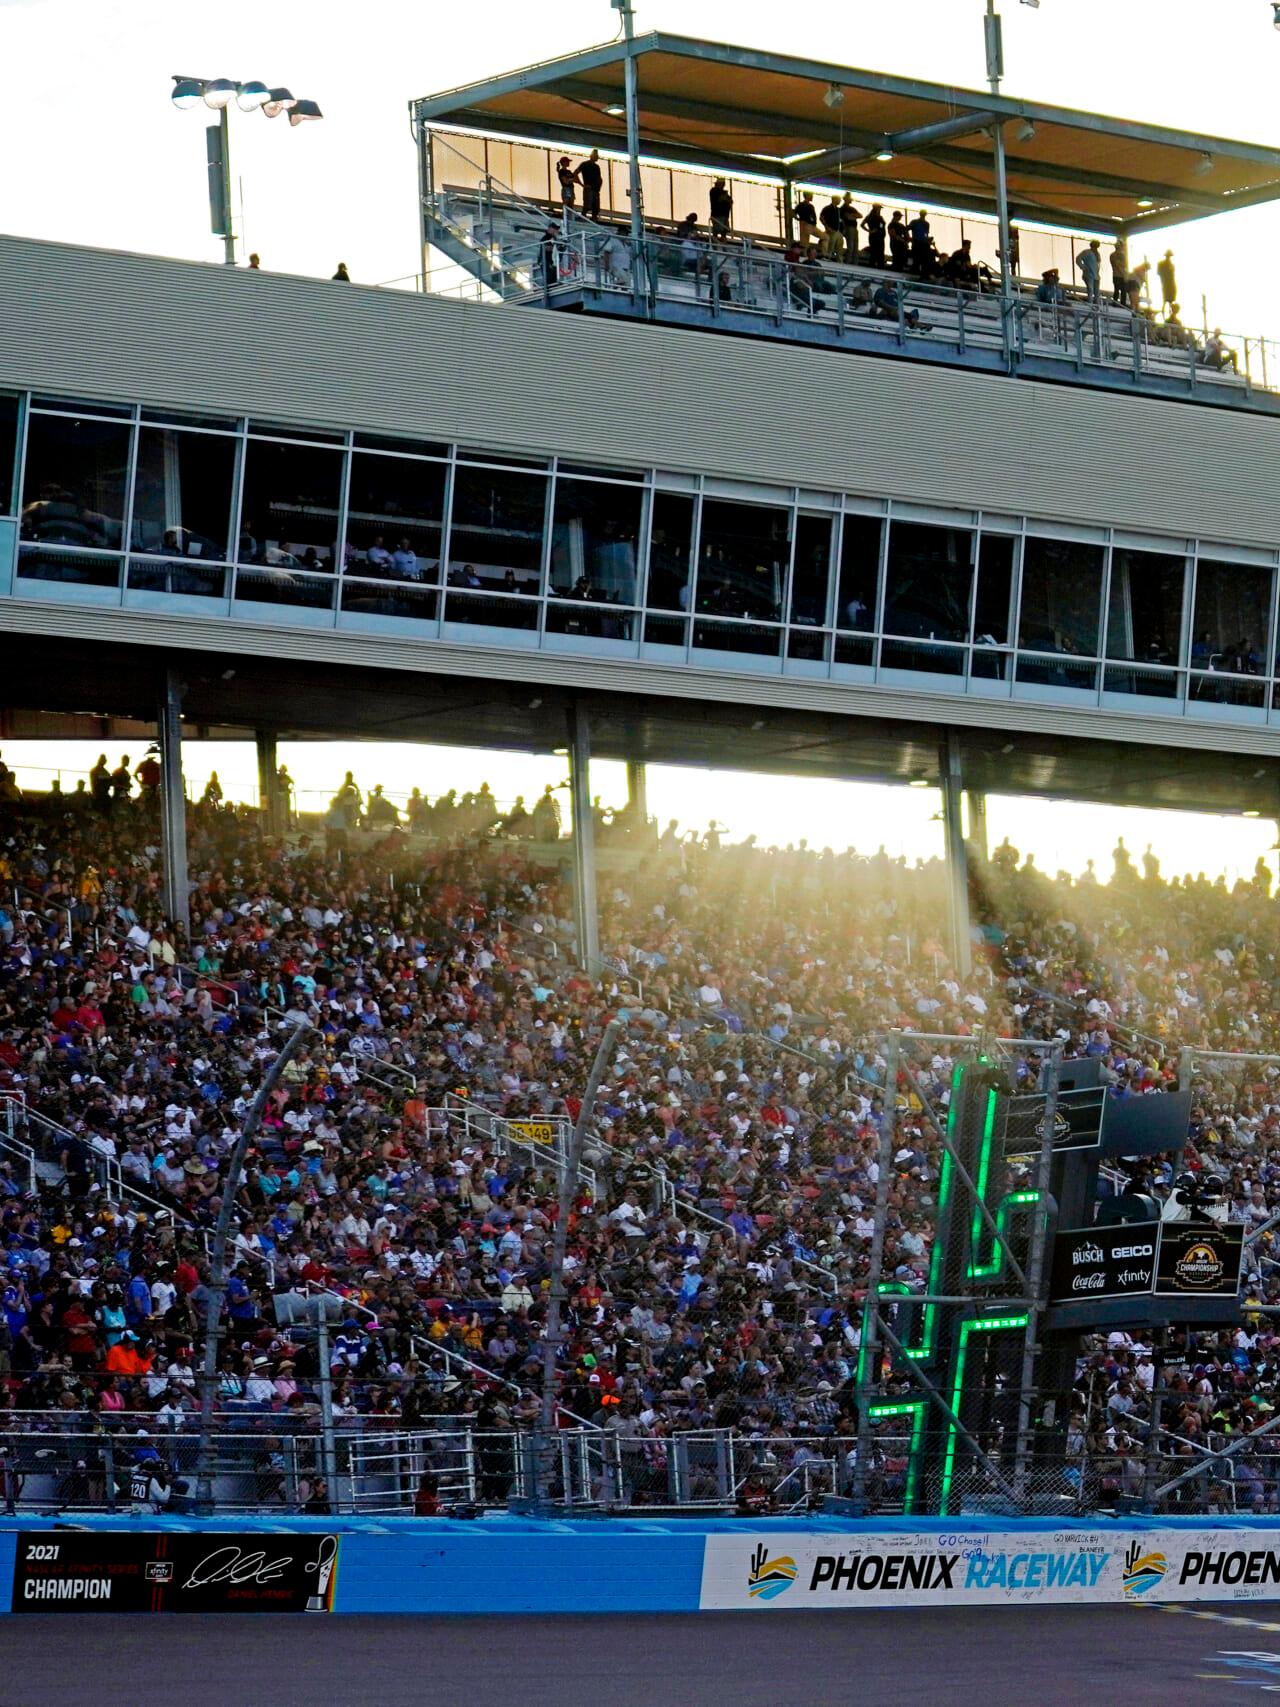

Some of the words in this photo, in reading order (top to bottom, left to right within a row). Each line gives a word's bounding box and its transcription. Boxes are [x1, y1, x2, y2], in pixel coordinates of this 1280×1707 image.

[1072, 1249, 1104, 1265] BUSCH
[1111, 1244, 1153, 1259] GEICO
[1180, 1263, 1219, 1272] CHAMPIONSHIP
[1117, 1269, 1151, 1286] xfinity
[131, 1483, 146, 1498] 120
[26, 1545, 60, 1560] 2021
[809, 1555, 960, 1590] PHOENIX
[964, 1552, 1111, 1588] RACEWAY
[24, 1578, 112, 1599] CHAMPION
